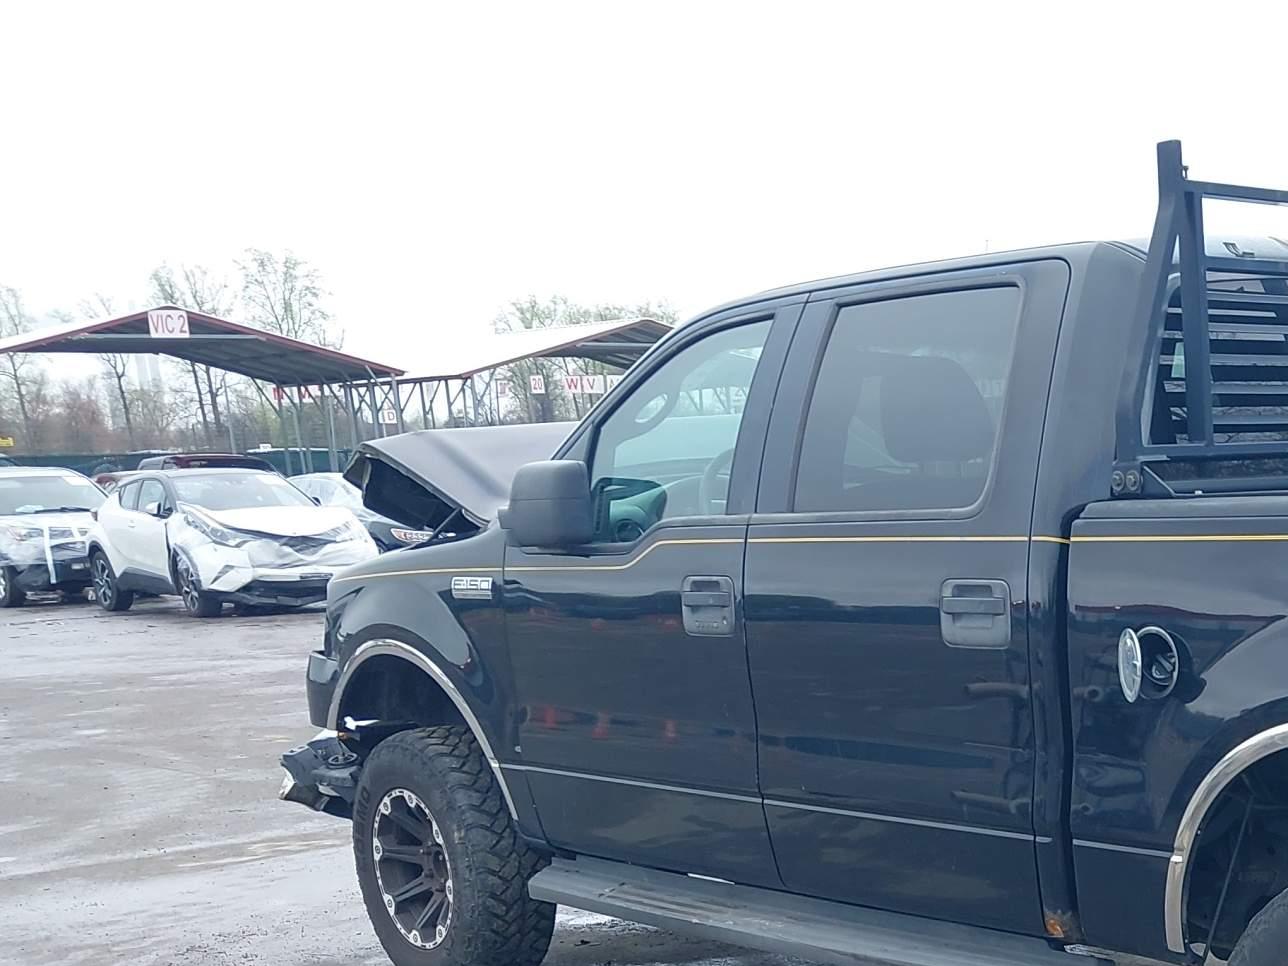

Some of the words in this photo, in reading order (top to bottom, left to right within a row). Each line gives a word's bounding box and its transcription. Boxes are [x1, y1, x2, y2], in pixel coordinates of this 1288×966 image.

[149, 313, 175, 334] VIC
[177, 314, 187, 334] 2
[532, 378, 543, 391] 20
[566, 377, 578, 391] W
